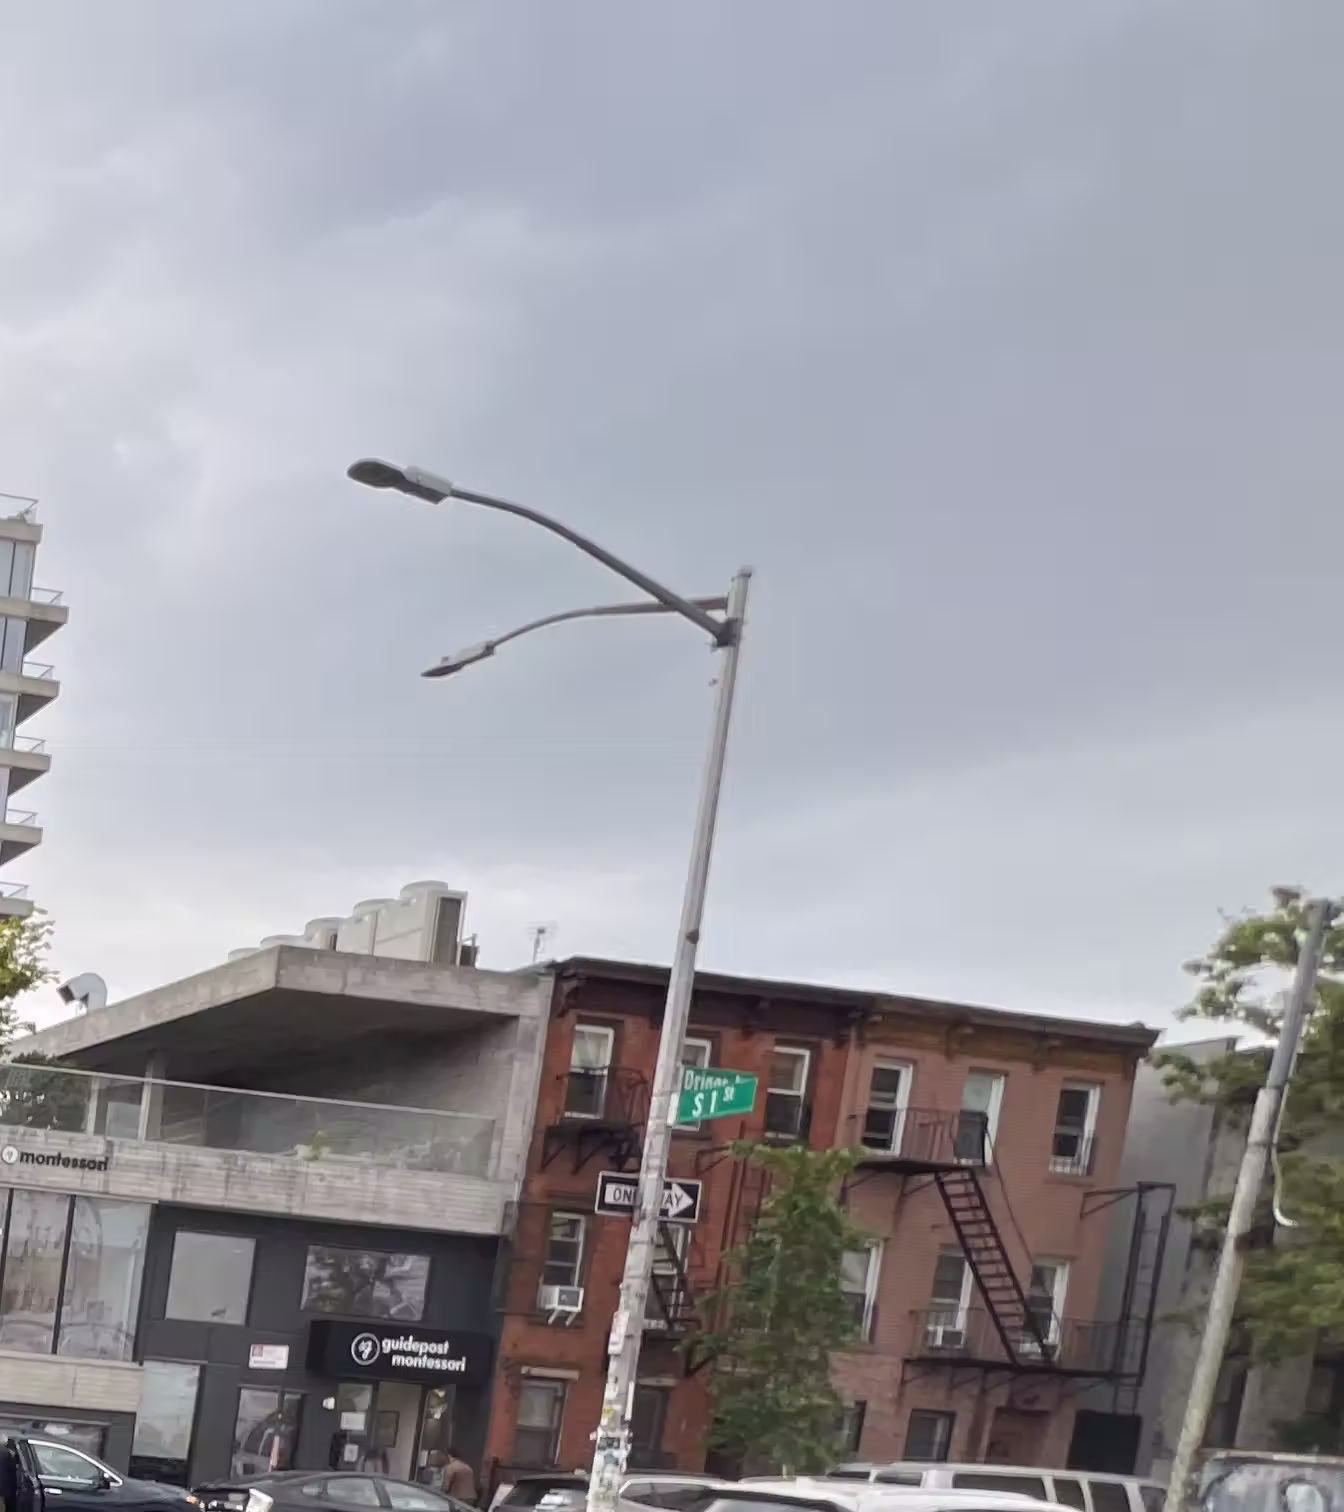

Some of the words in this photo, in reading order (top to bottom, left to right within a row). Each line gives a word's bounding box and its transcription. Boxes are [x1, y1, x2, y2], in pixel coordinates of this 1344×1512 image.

[692, 1092, 705, 1118] S
[19, 1151, 109, 1172] montessori
[662, 1191, 683, 1206] AY
[381, 1336, 450, 1356] guidepost
[391, 1351, 467, 1373] montessori
